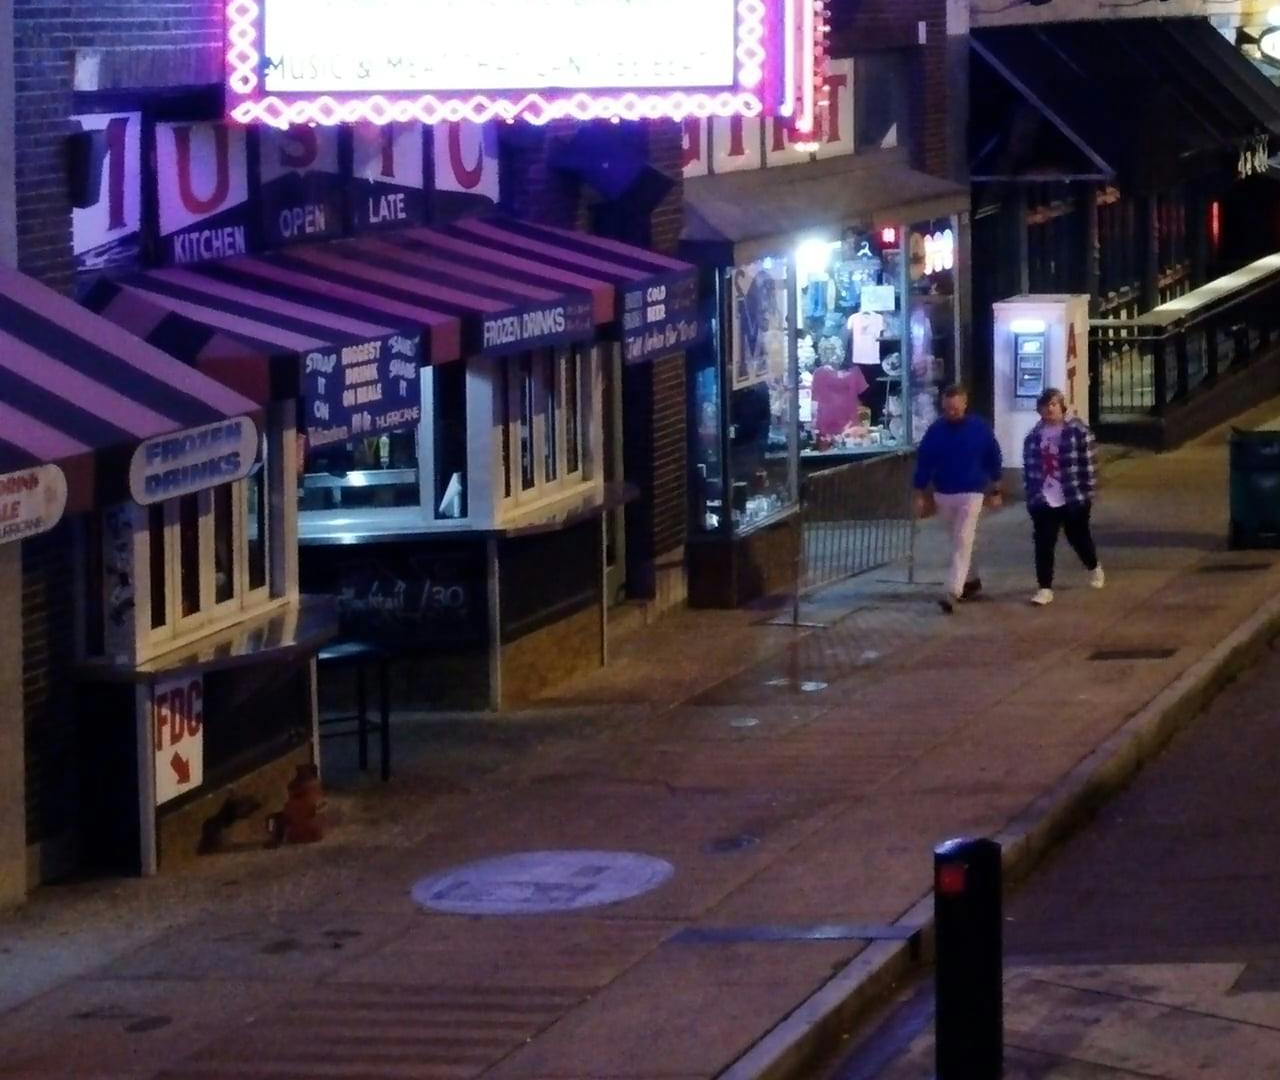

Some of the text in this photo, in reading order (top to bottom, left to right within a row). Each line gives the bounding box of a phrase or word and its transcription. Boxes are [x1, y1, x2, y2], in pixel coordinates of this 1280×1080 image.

[278, 203, 326, 239] OPEN
[369, 192, 407, 225] LATE
[173, 225, 247, 264] KITCHEN
[483, 315, 522, 349] FROZEN
[522, 306, 565, 339] DRINKS
[144, 420, 243, 467] FROZEN
[144, 451, 242, 496] DRINKS
